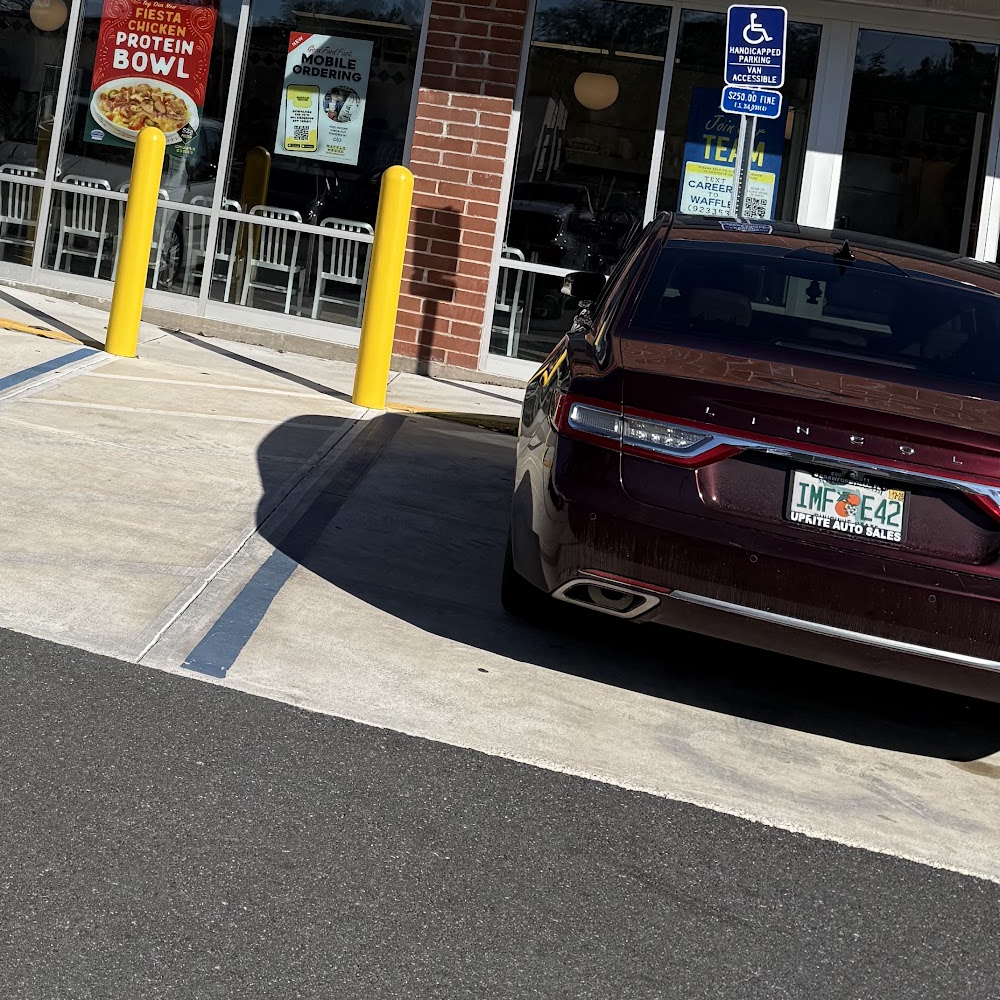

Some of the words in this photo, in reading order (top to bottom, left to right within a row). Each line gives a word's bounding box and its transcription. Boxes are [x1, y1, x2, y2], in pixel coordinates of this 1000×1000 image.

[135, 7, 181, 24] FIESTA
[128, 20, 187, 37] CHICKEN
[115, 31, 194, 55] PROTEIN
[291, 36, 304, 47] NEW
[729, 46, 781, 57] HANDICAPPED
[112, 48, 190, 79] BOWL
[301, 52, 357, 70] MOBILE
[738, 55, 771, 64] PARKING
[292, 64, 362, 82] ORDERING
[747, 66, 762, 74] VAN
[732, 73, 777, 84] ACCESSIBLE
[728, 91, 757, 103] $250.00
[760, 95, 776, 105] FINE
[705, 115, 735, 134] Join
[703, 134, 765, 167] TEAM
[688, 180, 733, 193] CAREER
[704, 176, 727, 184] TEXT
[690, 195, 731, 209] WAFFLE
[687, 204, 730, 216] (923353
[796, 482, 836, 513] IMF
[860, 494, 901, 528] E42
[832, 521, 863, 535] AUTO
[865, 527, 902, 542] SALES
